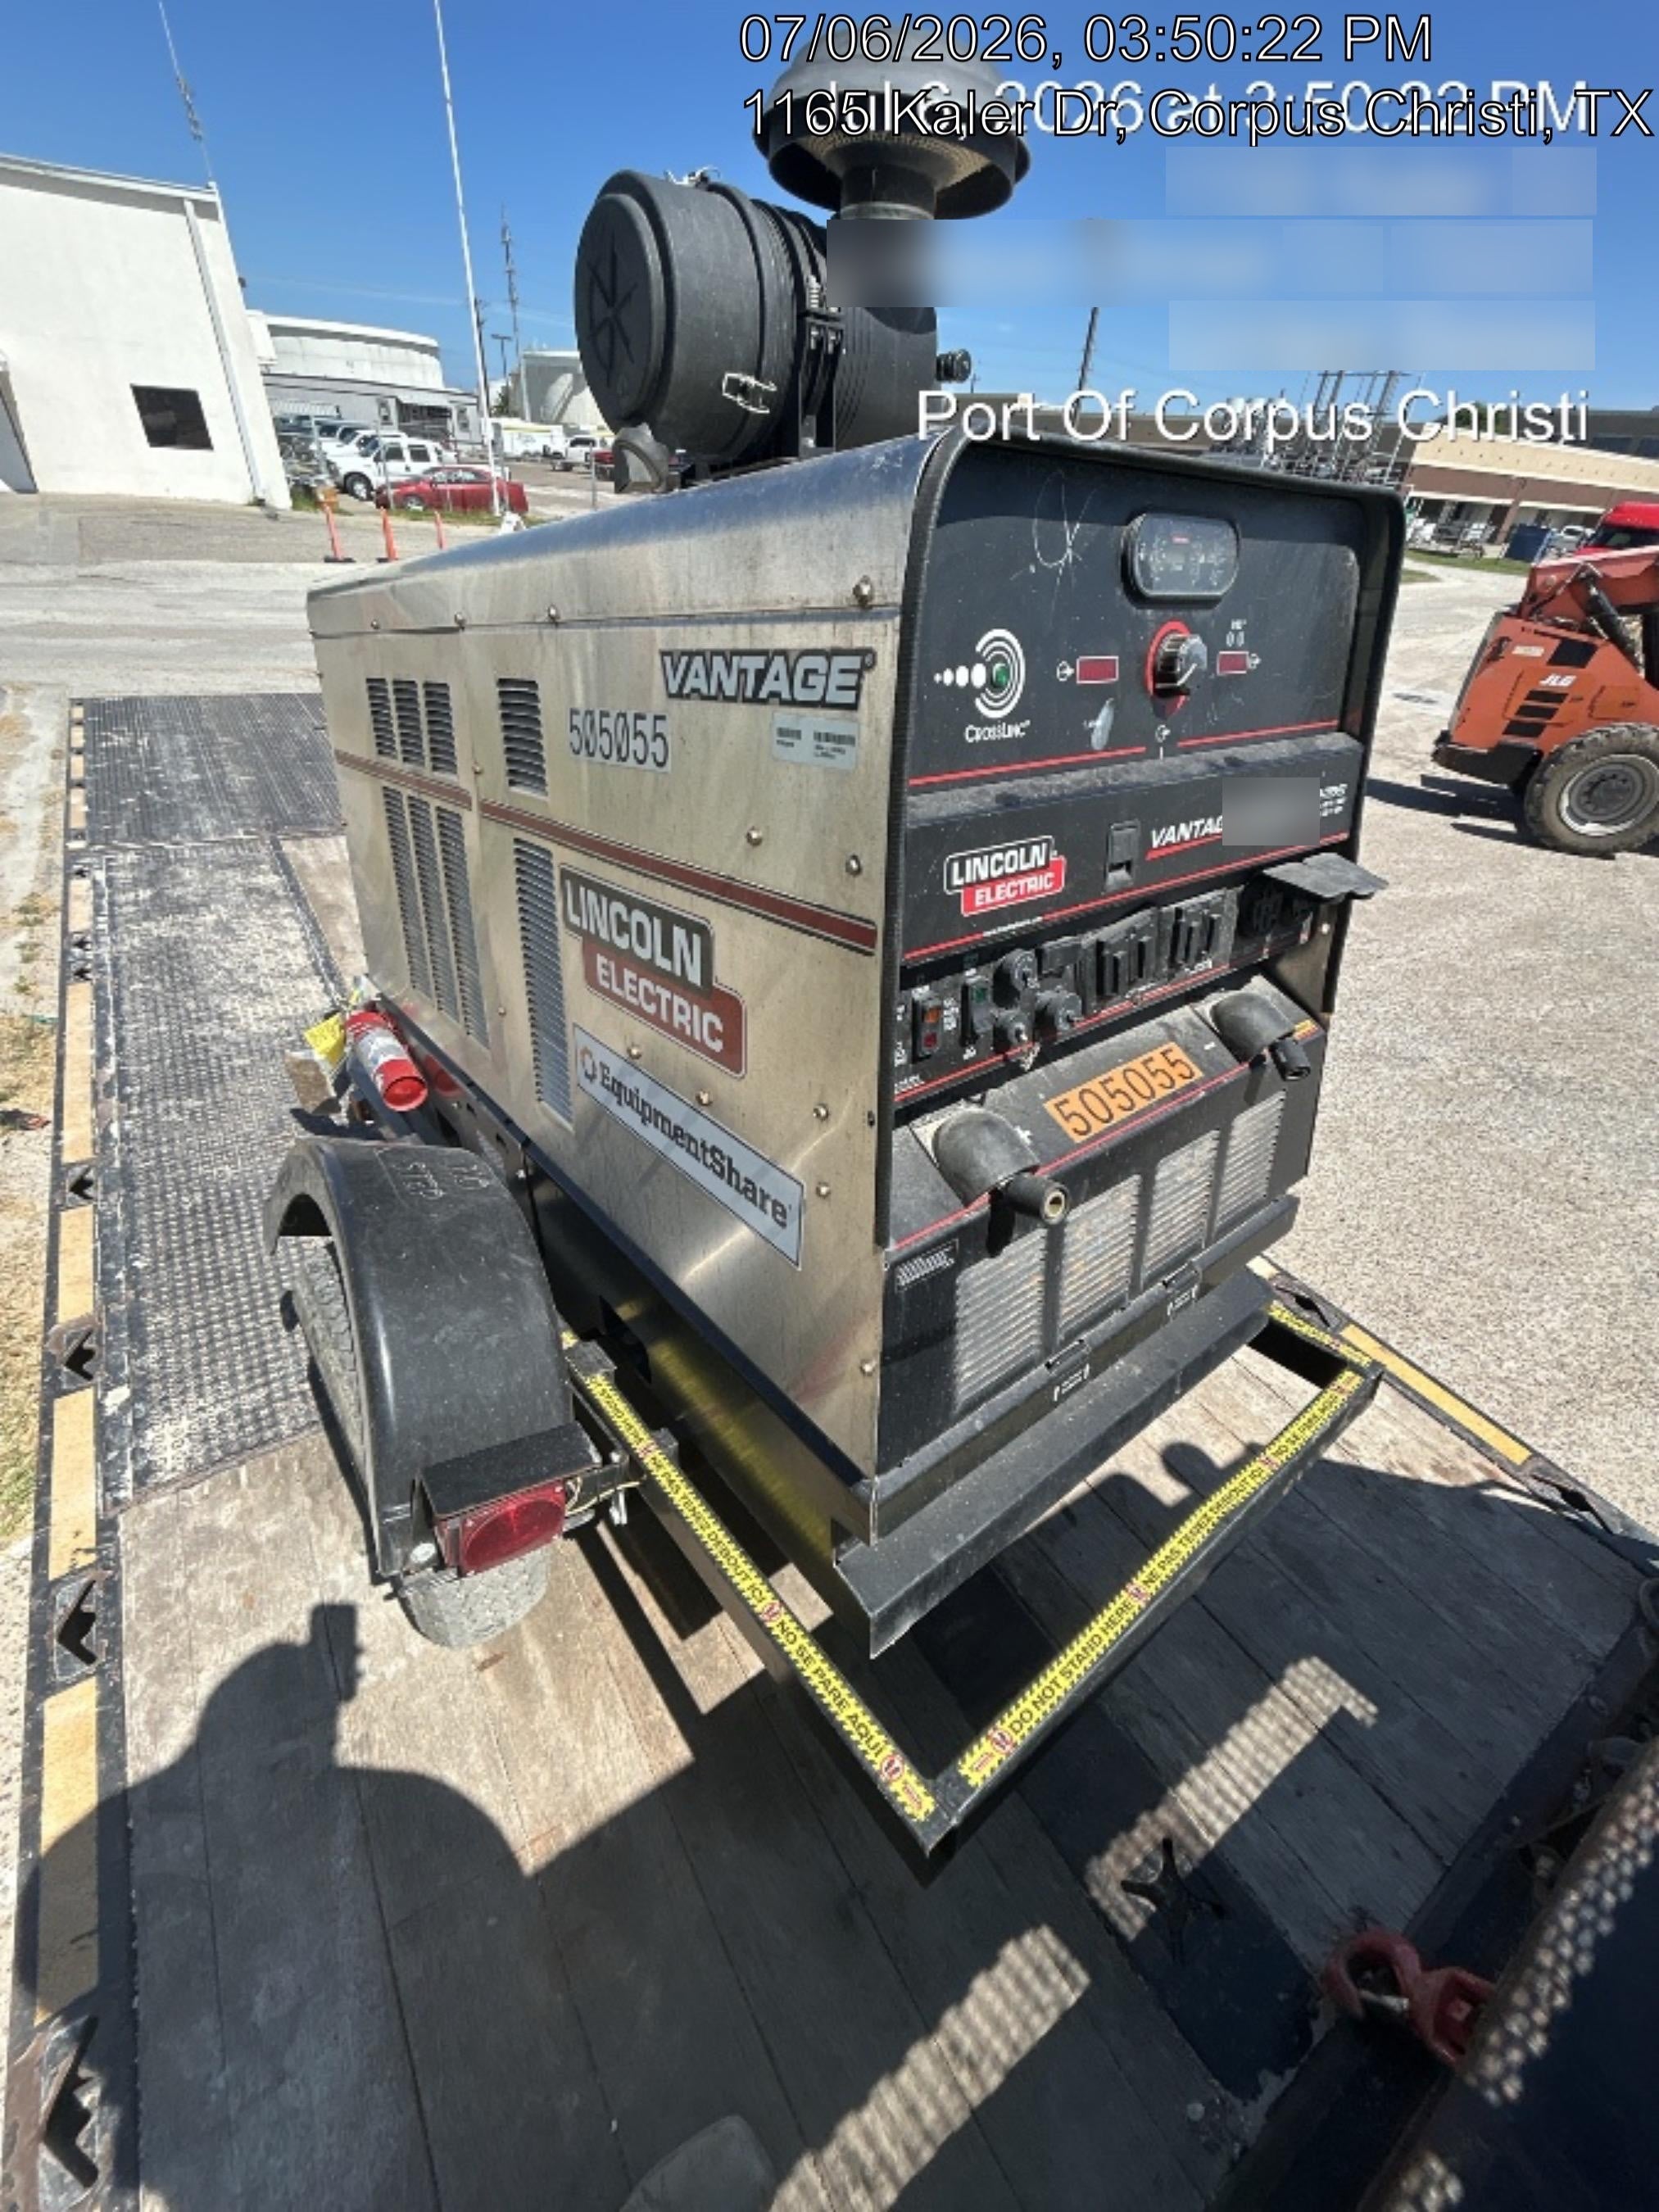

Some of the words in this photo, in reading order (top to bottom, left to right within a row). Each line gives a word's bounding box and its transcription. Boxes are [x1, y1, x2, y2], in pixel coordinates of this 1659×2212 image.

[660, 652, 864, 707] VANTAGE
[569, 707, 669, 768] 505055
[952, 842, 1048, 886] LINCOLN
[975, 872, 1055, 907] ELECTRIC
[565, 878, 702, 986] LINCOLN
[596, 953, 724, 1054] ELECTRIC
[1054, 1048, 1195, 1135] 505055
[599, 1061, 789, 1229] EquipmentShare
[773, 1618, 800, 1647] NO
[793, 1643, 817, 1668] SE
[810, 1665, 851, 1713] PARE
[1006, 1706, 1036, 1735] DO
[1029, 1675, 1064, 1711] NOT
[1057, 1631, 1105, 1681] STAND
[1098, 1598, 1135, 1636] HERE
